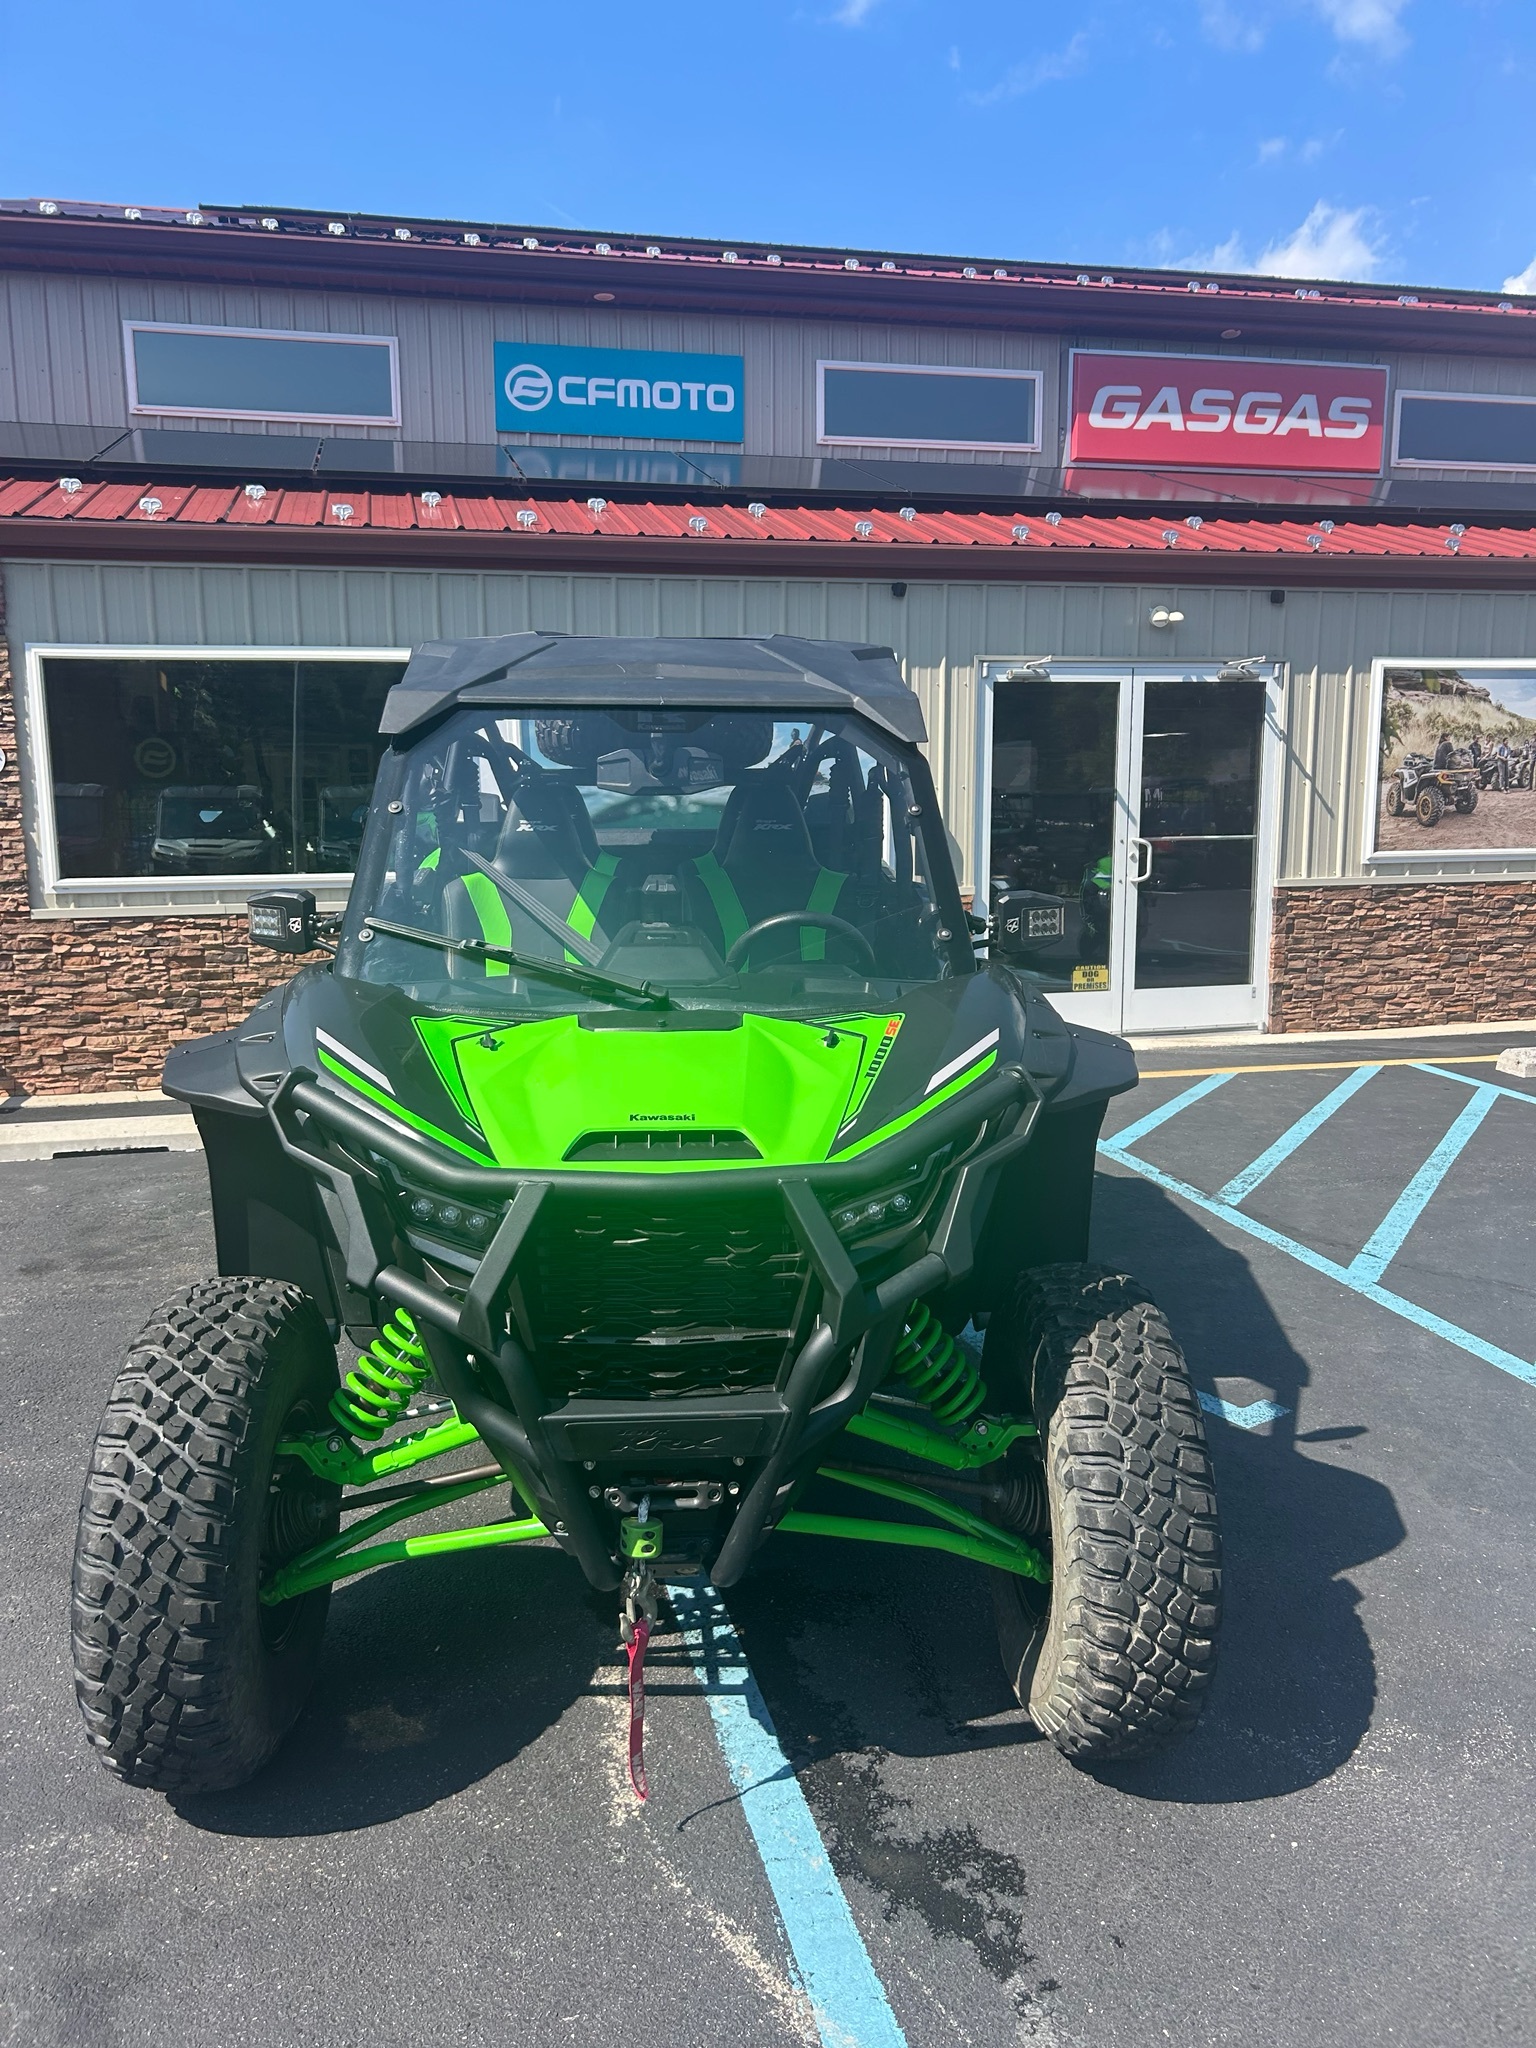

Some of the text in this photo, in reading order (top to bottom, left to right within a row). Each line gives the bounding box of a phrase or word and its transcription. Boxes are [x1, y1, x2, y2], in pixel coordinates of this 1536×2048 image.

[558, 376, 735, 413] CFMOTO
[1088, 385, 1373, 440] GASGAS
[629, 1113, 696, 1121] Kawasaki
